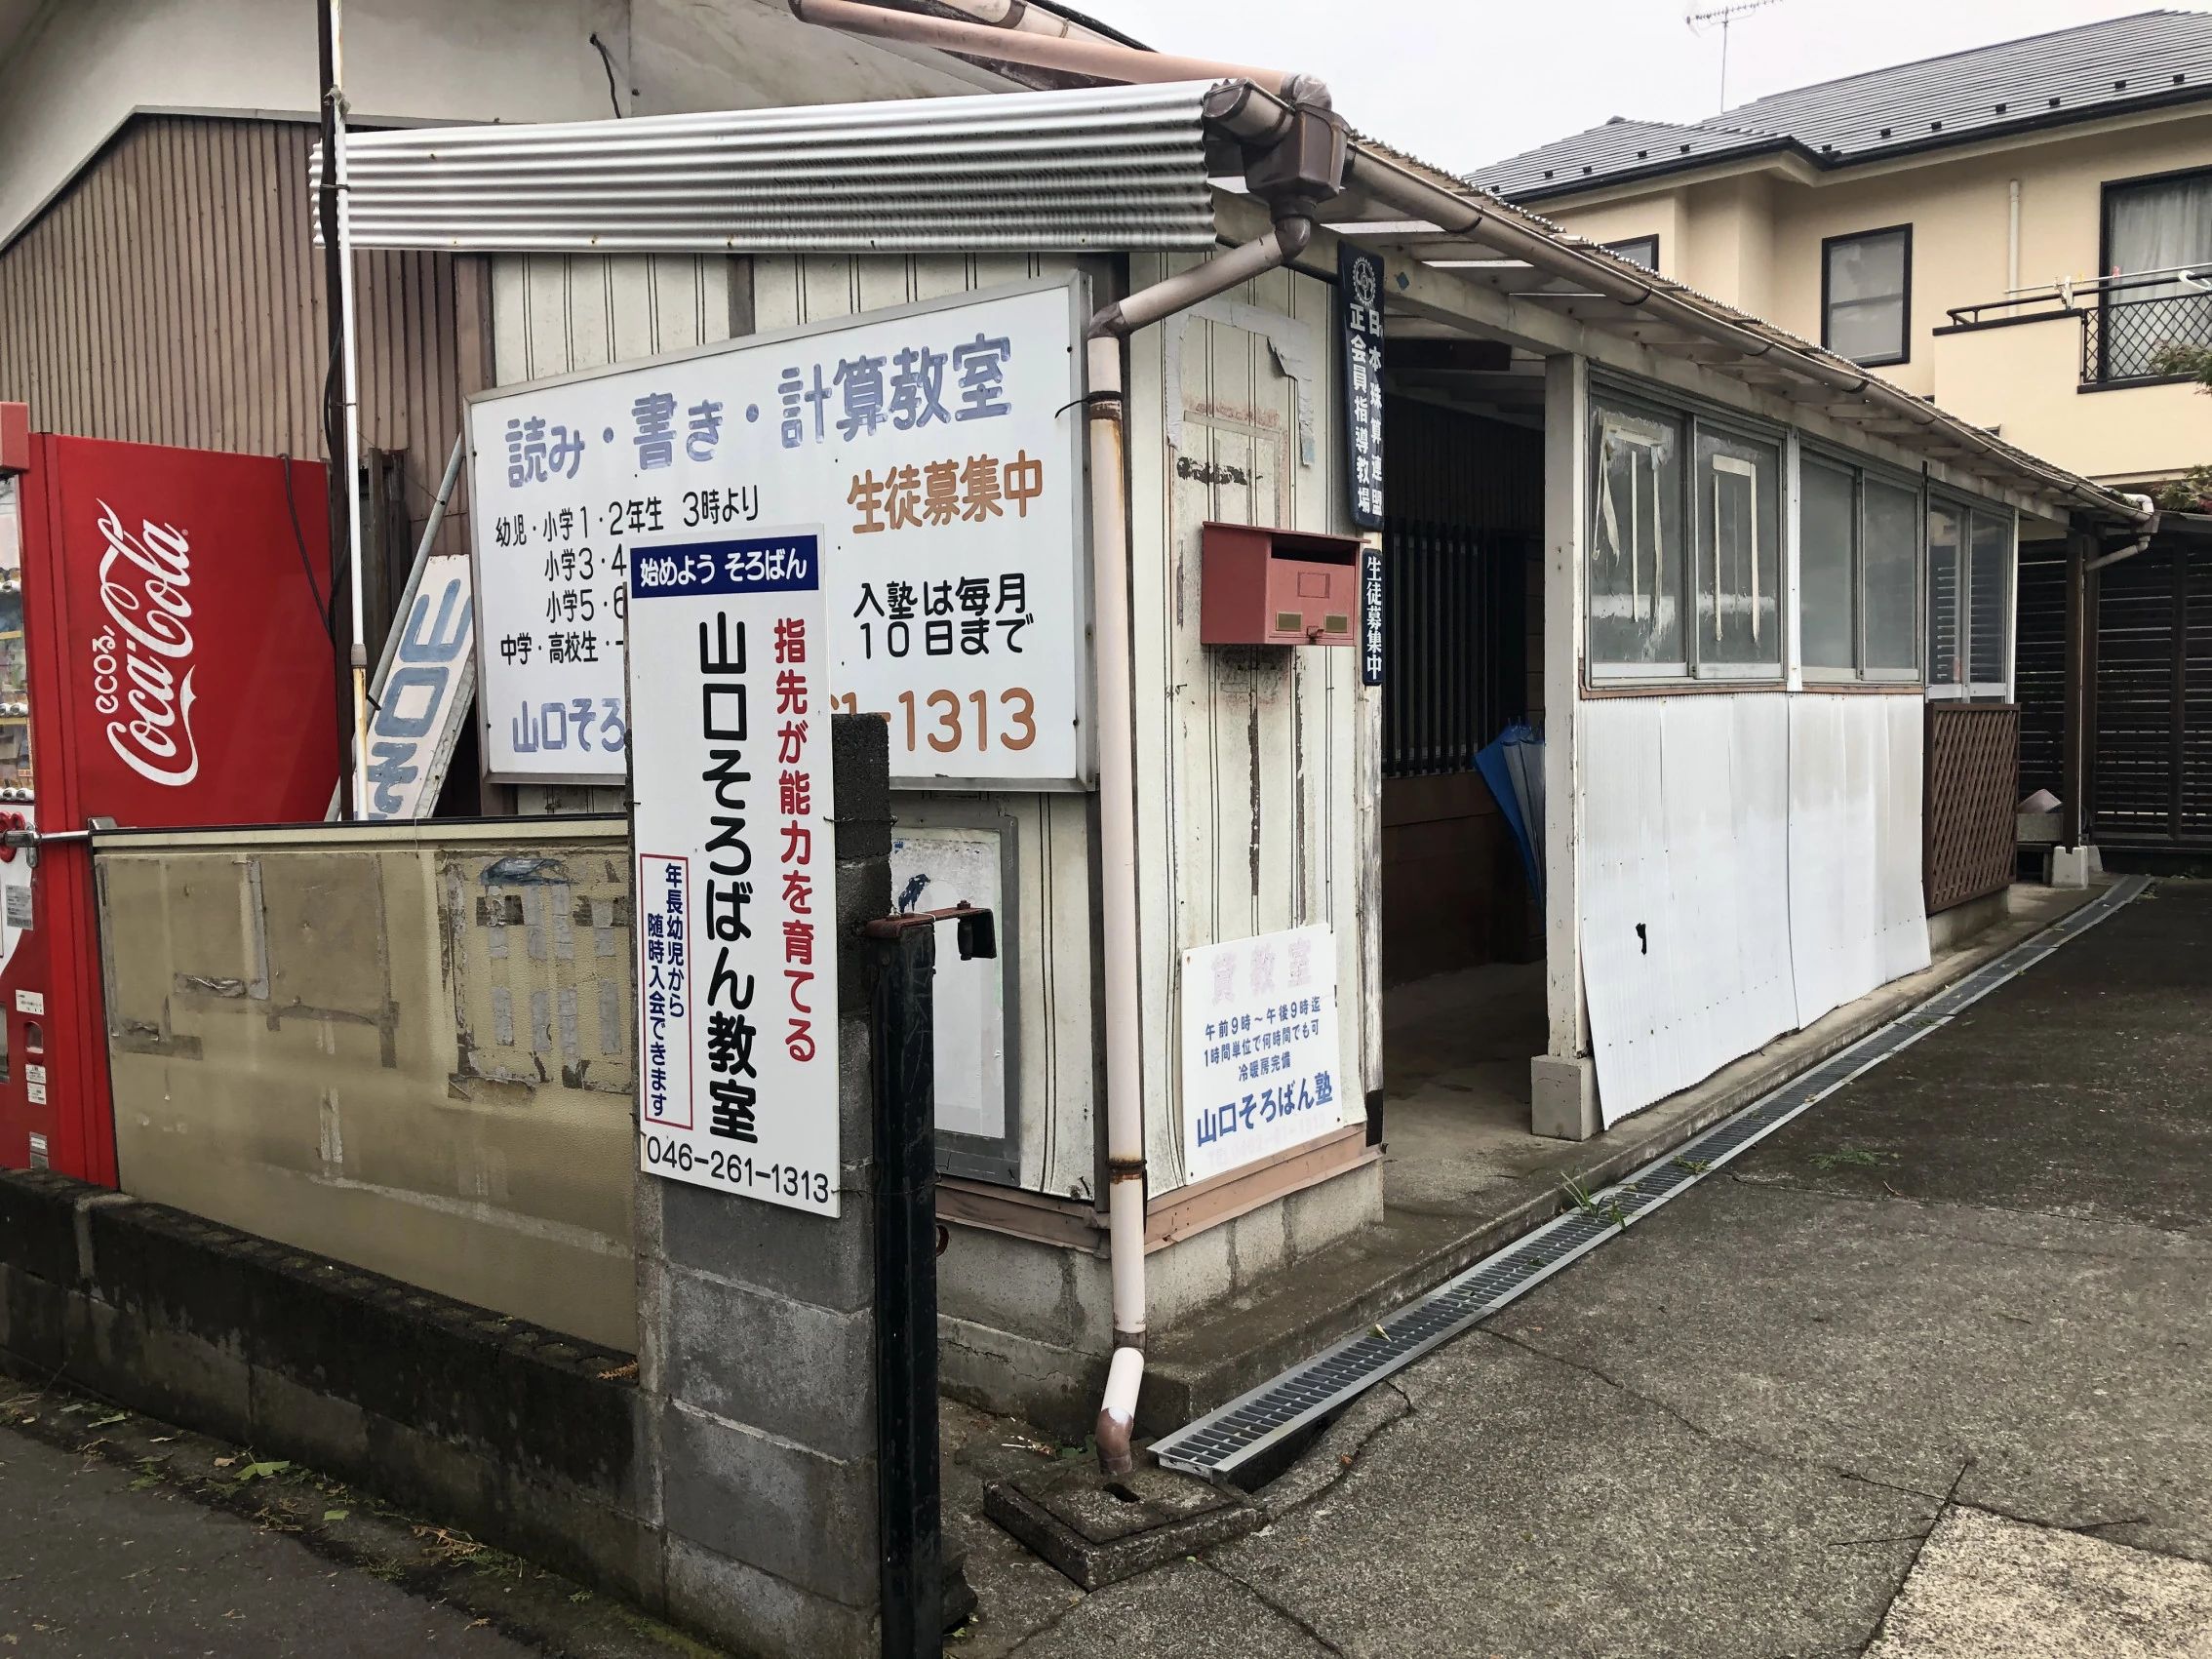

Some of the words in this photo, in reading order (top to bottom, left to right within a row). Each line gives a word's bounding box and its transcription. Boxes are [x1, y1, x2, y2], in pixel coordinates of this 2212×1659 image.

[504, 333, 1011, 488] 読み・書き・計算教室
[683, 485, 758, 527] 3時より
[847, 450, 1043, 534] 生徒募集中
[640, 554, 716, 587] 始めよう
[725, 547, 808, 582] そろばん
[853, 573, 1025, 620] 入塾は毎月
[96, 497, 198, 786] Coca-Cola
[859, 613, 1034, 659] 10日まで
[1366, 552, 1382, 680] 生徒募集中
[354, 578, 473, 820] 山口そ
[512, 698, 625, 753] 山口そろ
[831, 687, 1037, 753] -1313
[699, 611, 758, 1144] 山口そろばん教室
[773, 617, 815, 1062] 指先が能力を育てる
[665, 862, 685, 1018] 年長幼児から
[648, 913, 667, 1117] 随時入会できます
[1205, 1018, 1320, 1068] 1時間単位で何時間でも可
[1238, 1050, 1291, 1083] 冷暖房完備
[1197, 1069, 1333, 1148] 山口そろばん塾
[647, 1135, 829, 1204] 046-261-1313
